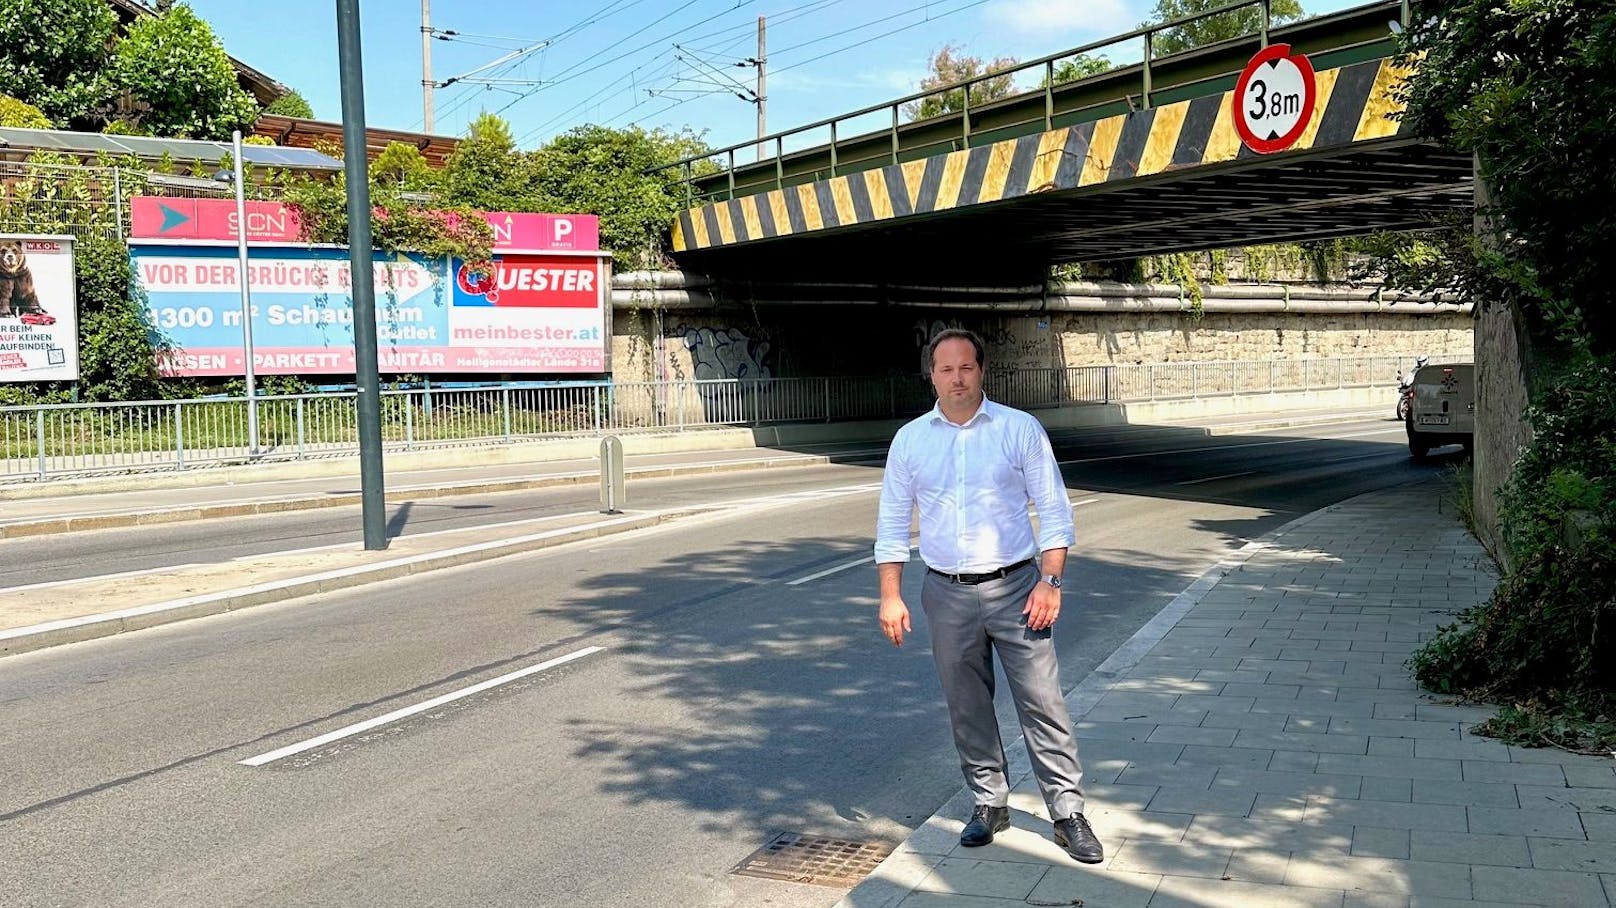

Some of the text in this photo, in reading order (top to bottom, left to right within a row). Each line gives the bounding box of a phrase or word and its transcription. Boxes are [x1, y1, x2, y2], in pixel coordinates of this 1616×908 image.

[1249, 80, 1299, 120] 3,8m
[554, 219, 573, 241] P
[144, 264, 188, 284] VOR
[195, 265, 235, 285] DER
[150, 306, 214, 329] 1300
[454, 325, 599, 340] meinbester.at
[253, 352, 341, 368] PARKETT
[378, 350, 445, 367] ANITÄR
